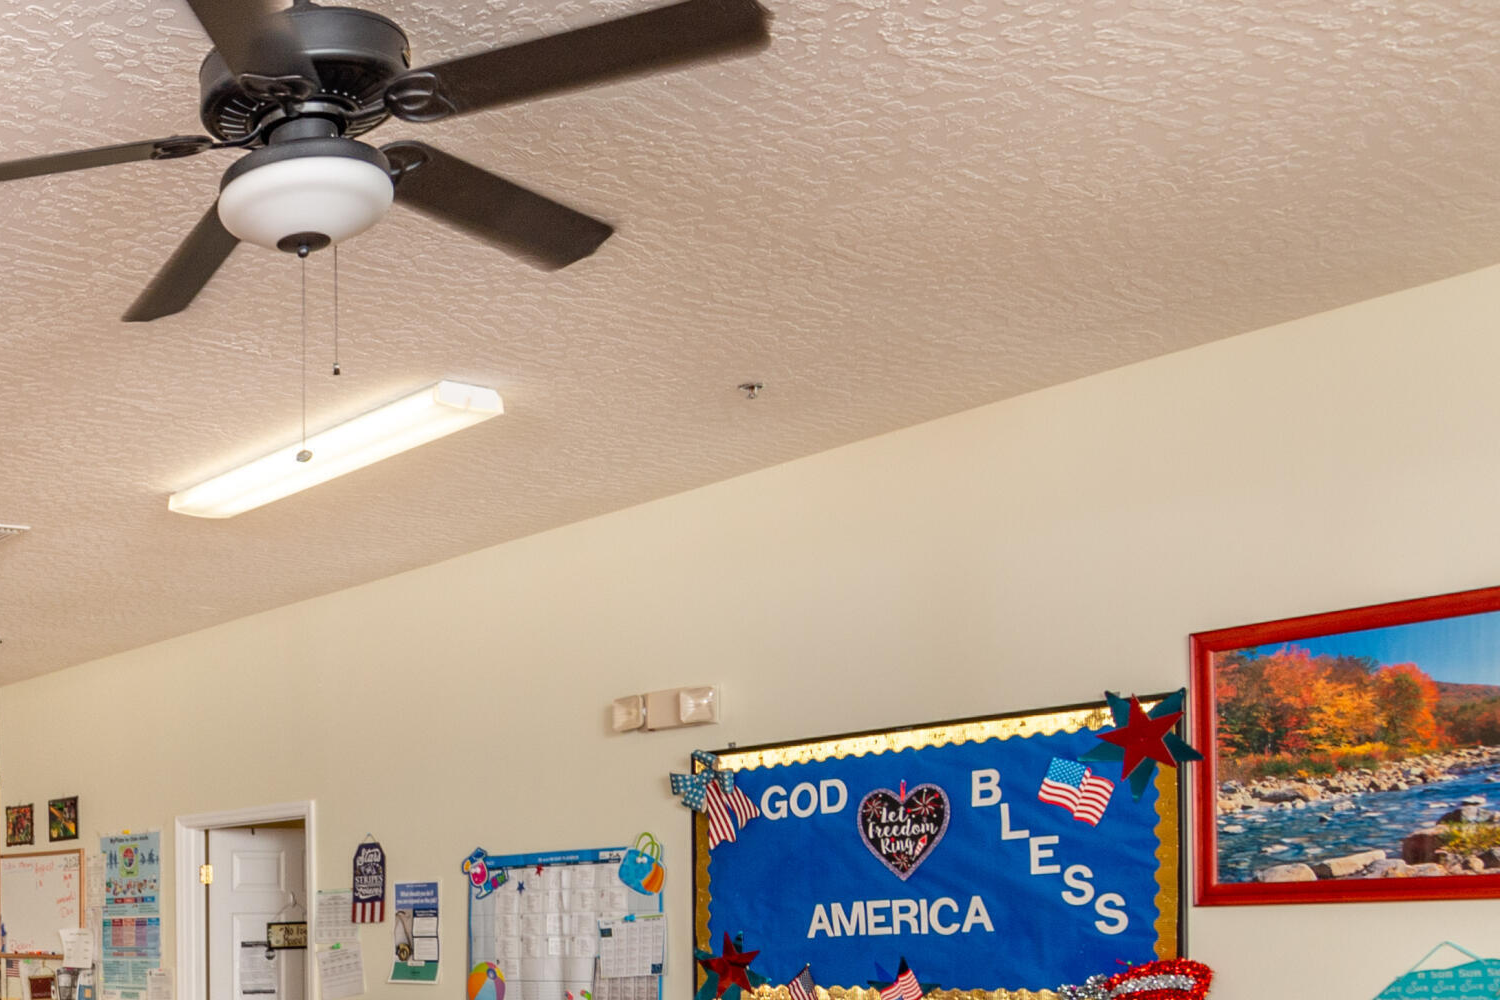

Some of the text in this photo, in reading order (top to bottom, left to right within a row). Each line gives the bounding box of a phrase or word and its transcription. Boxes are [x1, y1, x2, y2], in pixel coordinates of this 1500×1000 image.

[760, 778, 848, 821] GOD
[880, 805, 909, 823] Let
[880, 837, 915, 855] Ring
[971, 768, 1129, 935] BLESS
[807, 895, 995, 939] AMERICA
